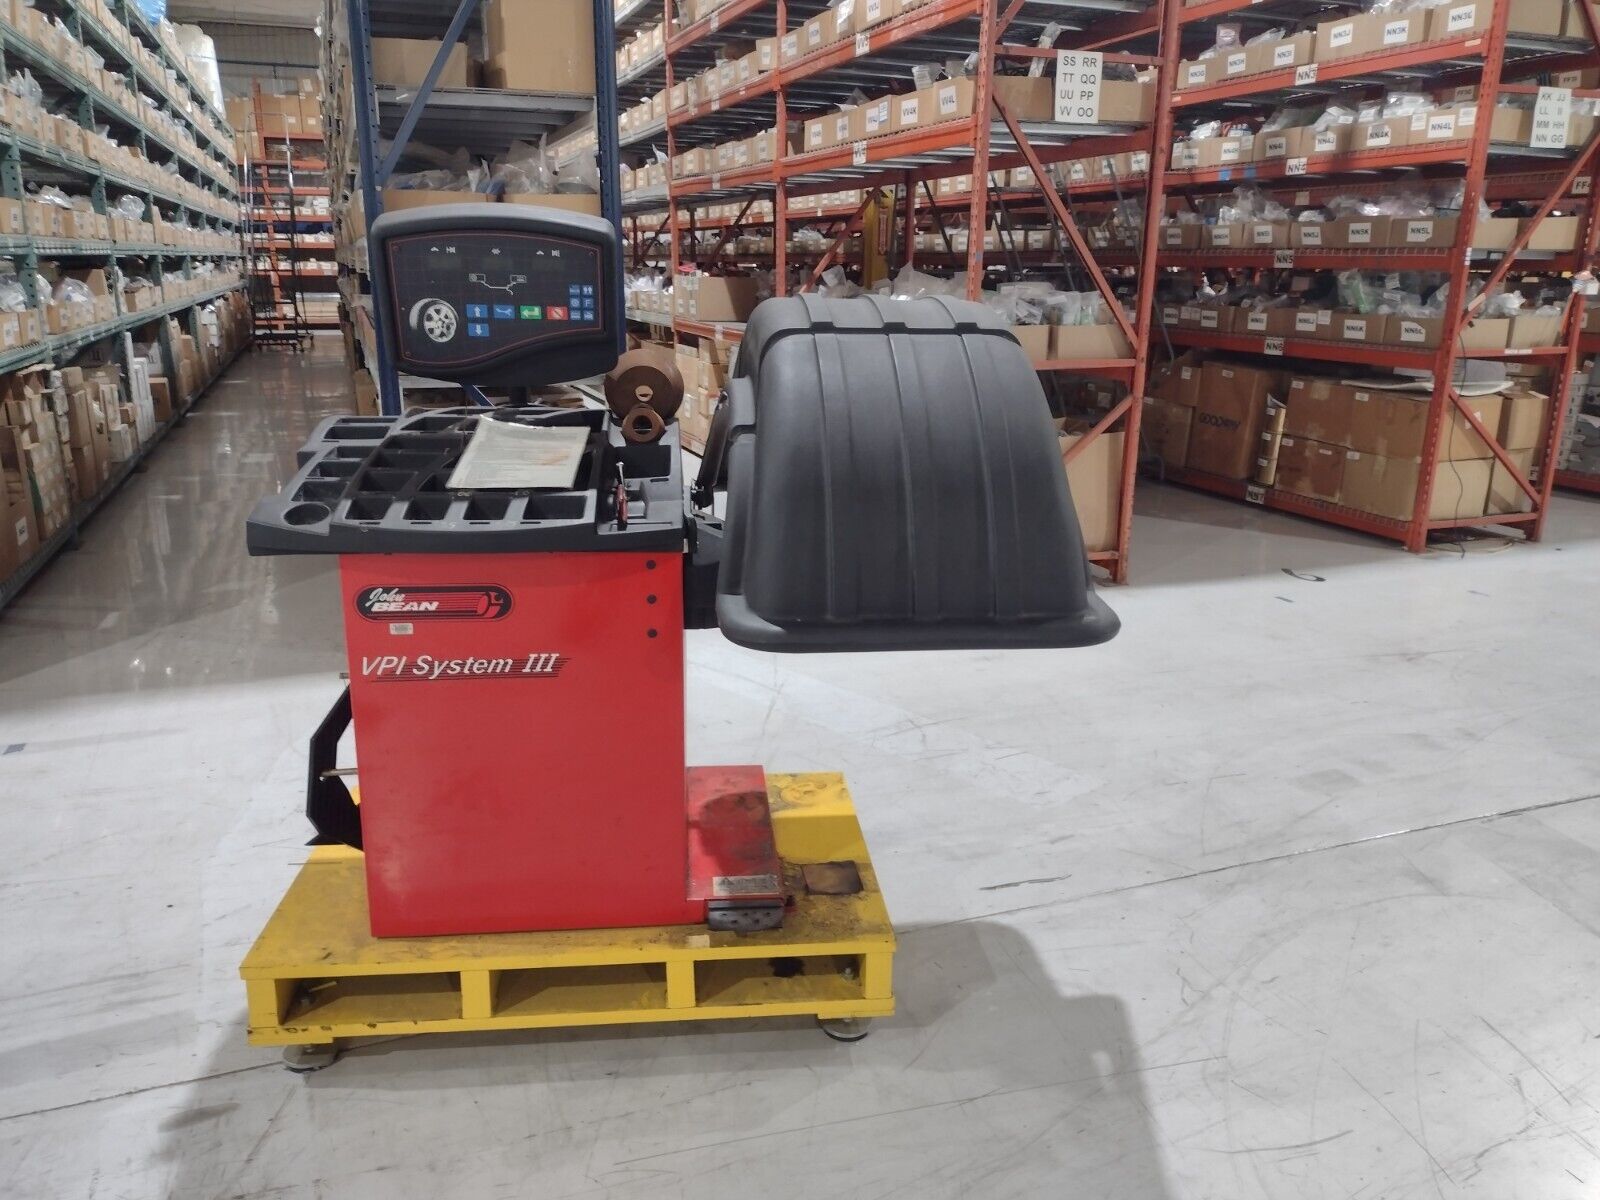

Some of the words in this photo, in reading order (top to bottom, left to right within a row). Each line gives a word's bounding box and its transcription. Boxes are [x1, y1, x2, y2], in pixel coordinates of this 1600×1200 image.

[1063, 56, 1076, 66] SS
[1082, 57, 1097, 68] RR
[1062, 73, 1075, 83] TT
[1080, 74, 1097, 85] QQ
[1060, 90, 1074, 100] UU
[1080, 91, 1094, 101] PP
[1540, 92, 1552, 101] KK
[1060, 106, 1072, 116] VV
[1077, 107, 1094, 117] OO
[1539, 106, 1548, 115] LL
[1535, 120, 1549, 129] MM
[1552, 121, 1565, 129] HH
[1535, 134, 1547, 143] NN
[1551, 134, 1564, 143] GG
[365, 588, 405, 607] John
[370, 601, 440, 612] BEAN
[361, 655, 407, 676] VPI
[412, 654, 514, 680] System
[522, 652, 560, 673] III
